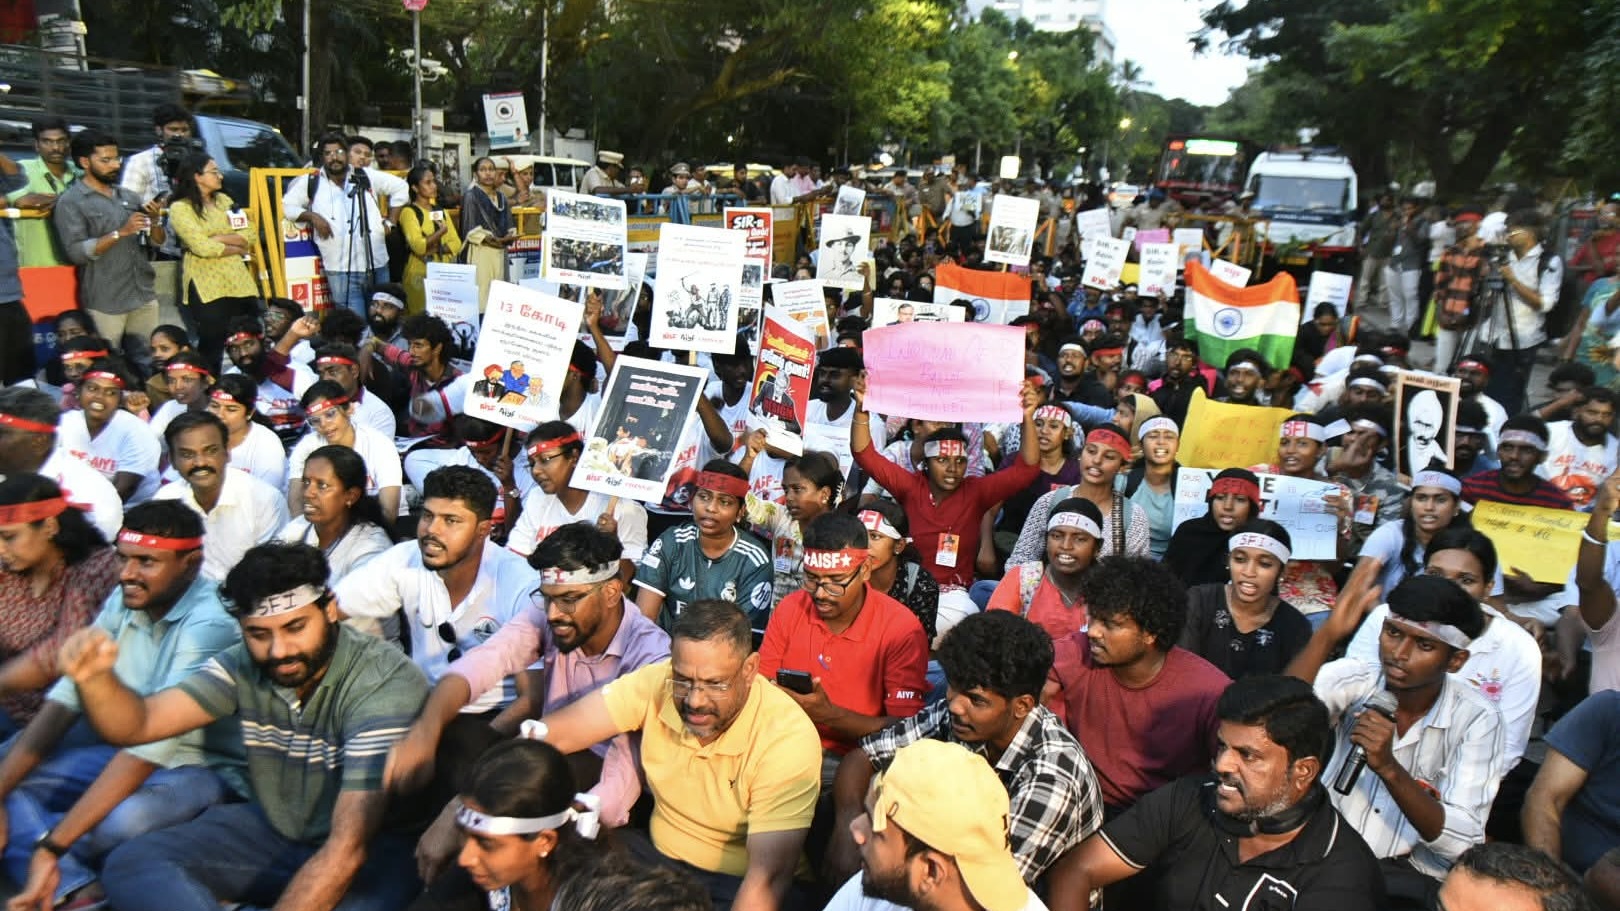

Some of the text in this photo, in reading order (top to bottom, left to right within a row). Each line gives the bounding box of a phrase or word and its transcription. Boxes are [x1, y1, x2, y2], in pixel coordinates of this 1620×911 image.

[500, 301, 513, 313] 13
[519, 303, 567, 333] கோடி
[1283, 420, 1308, 437] SFI
[1058, 513, 1080, 525] SFI
[1239, 534, 1266, 547] SFI
[809, 551, 841, 569] AISF
[895, 690, 916, 700] AIYF
